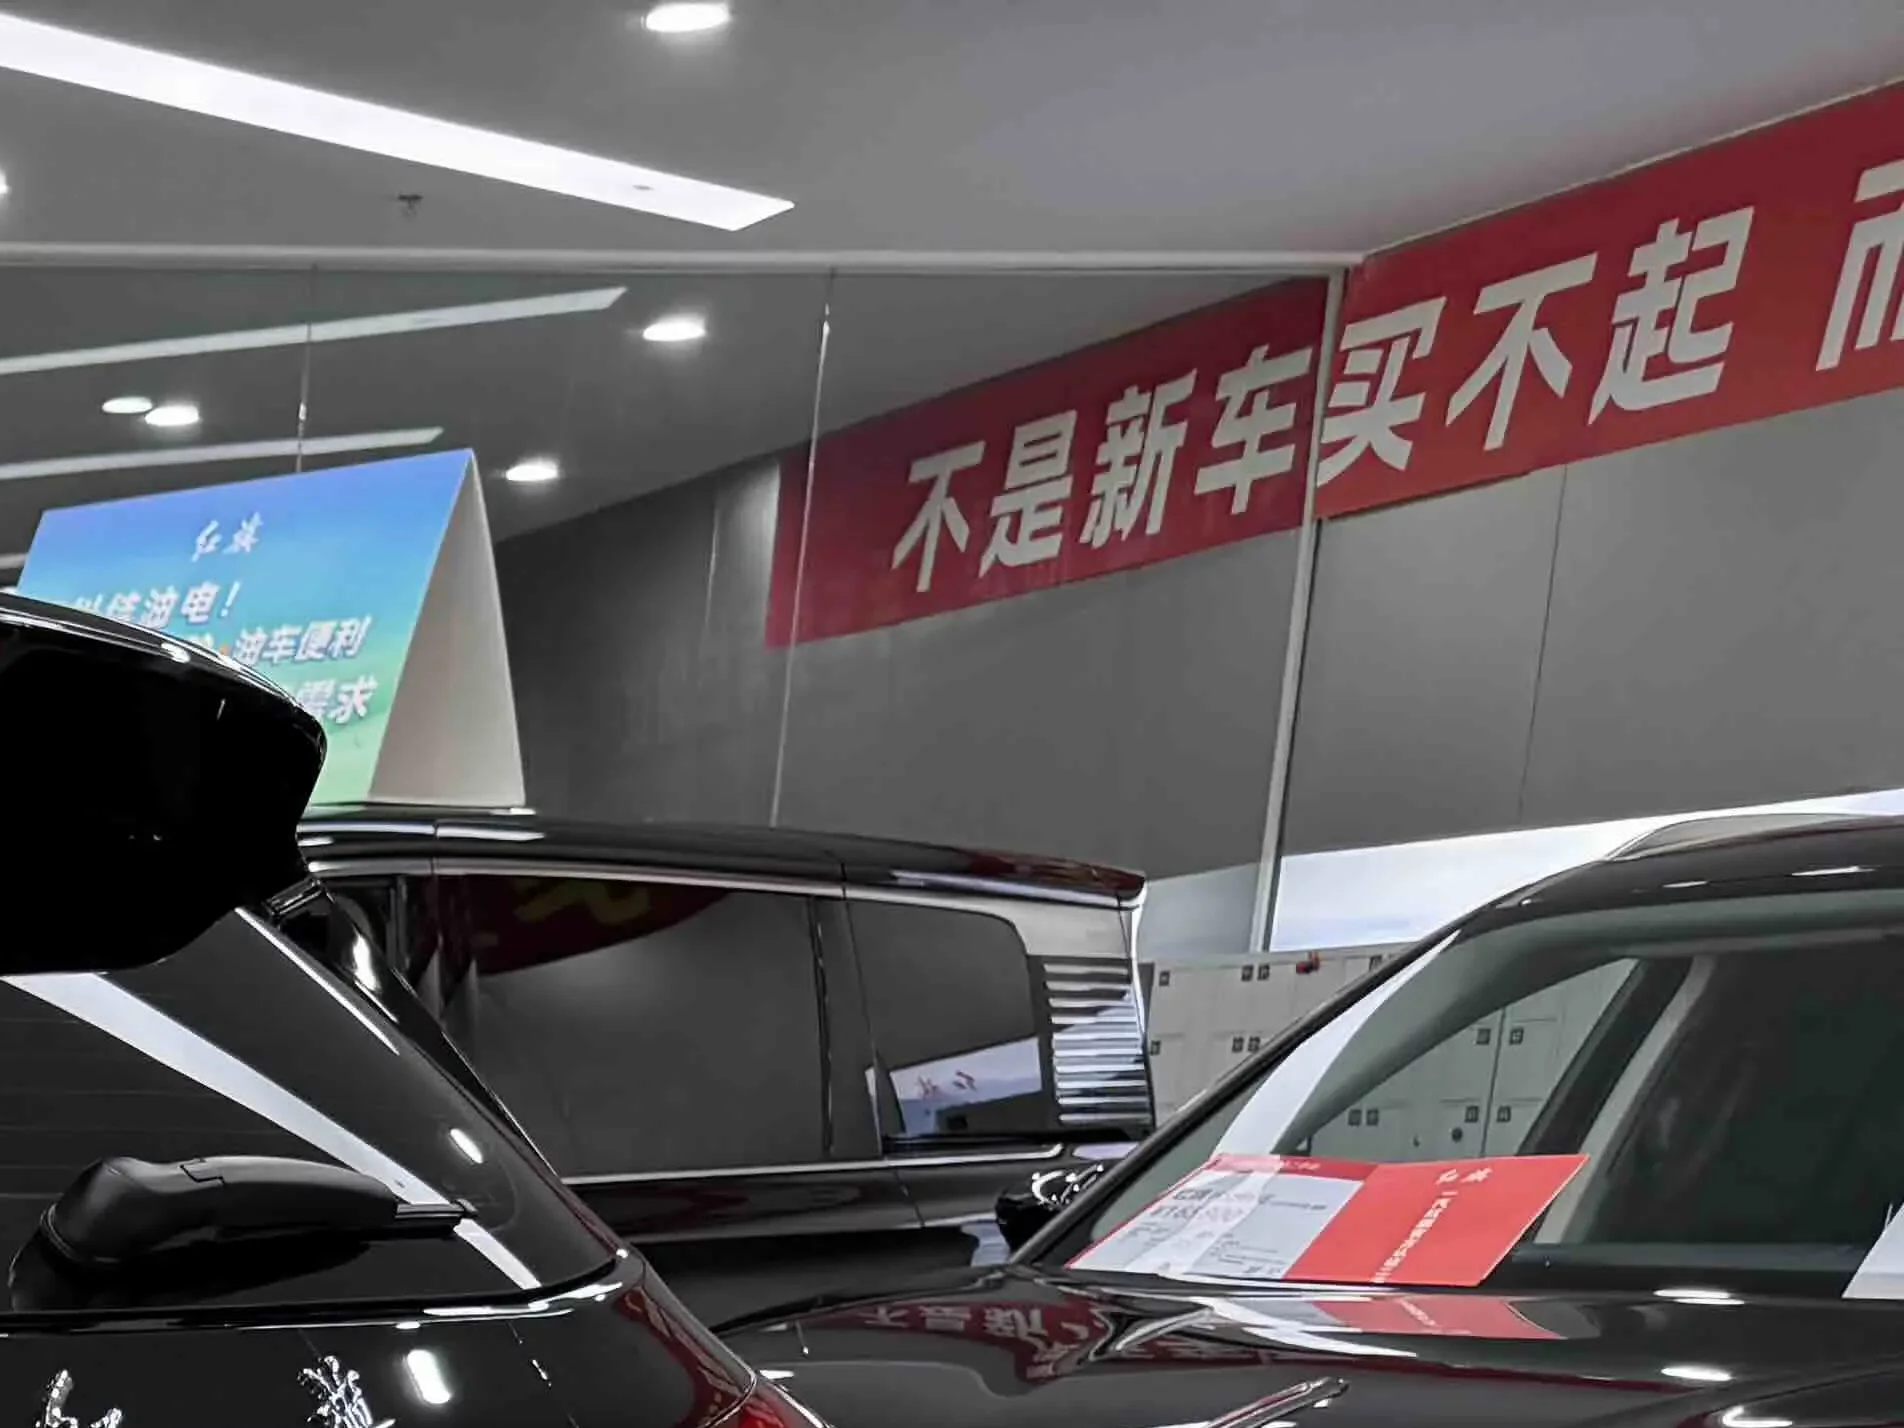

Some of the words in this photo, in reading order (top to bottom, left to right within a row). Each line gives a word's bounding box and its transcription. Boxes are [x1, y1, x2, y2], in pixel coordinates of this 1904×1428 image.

[892, 205, 1755, 593] 不是新车买不起
[232, 615, 372, 667] 油车便利
